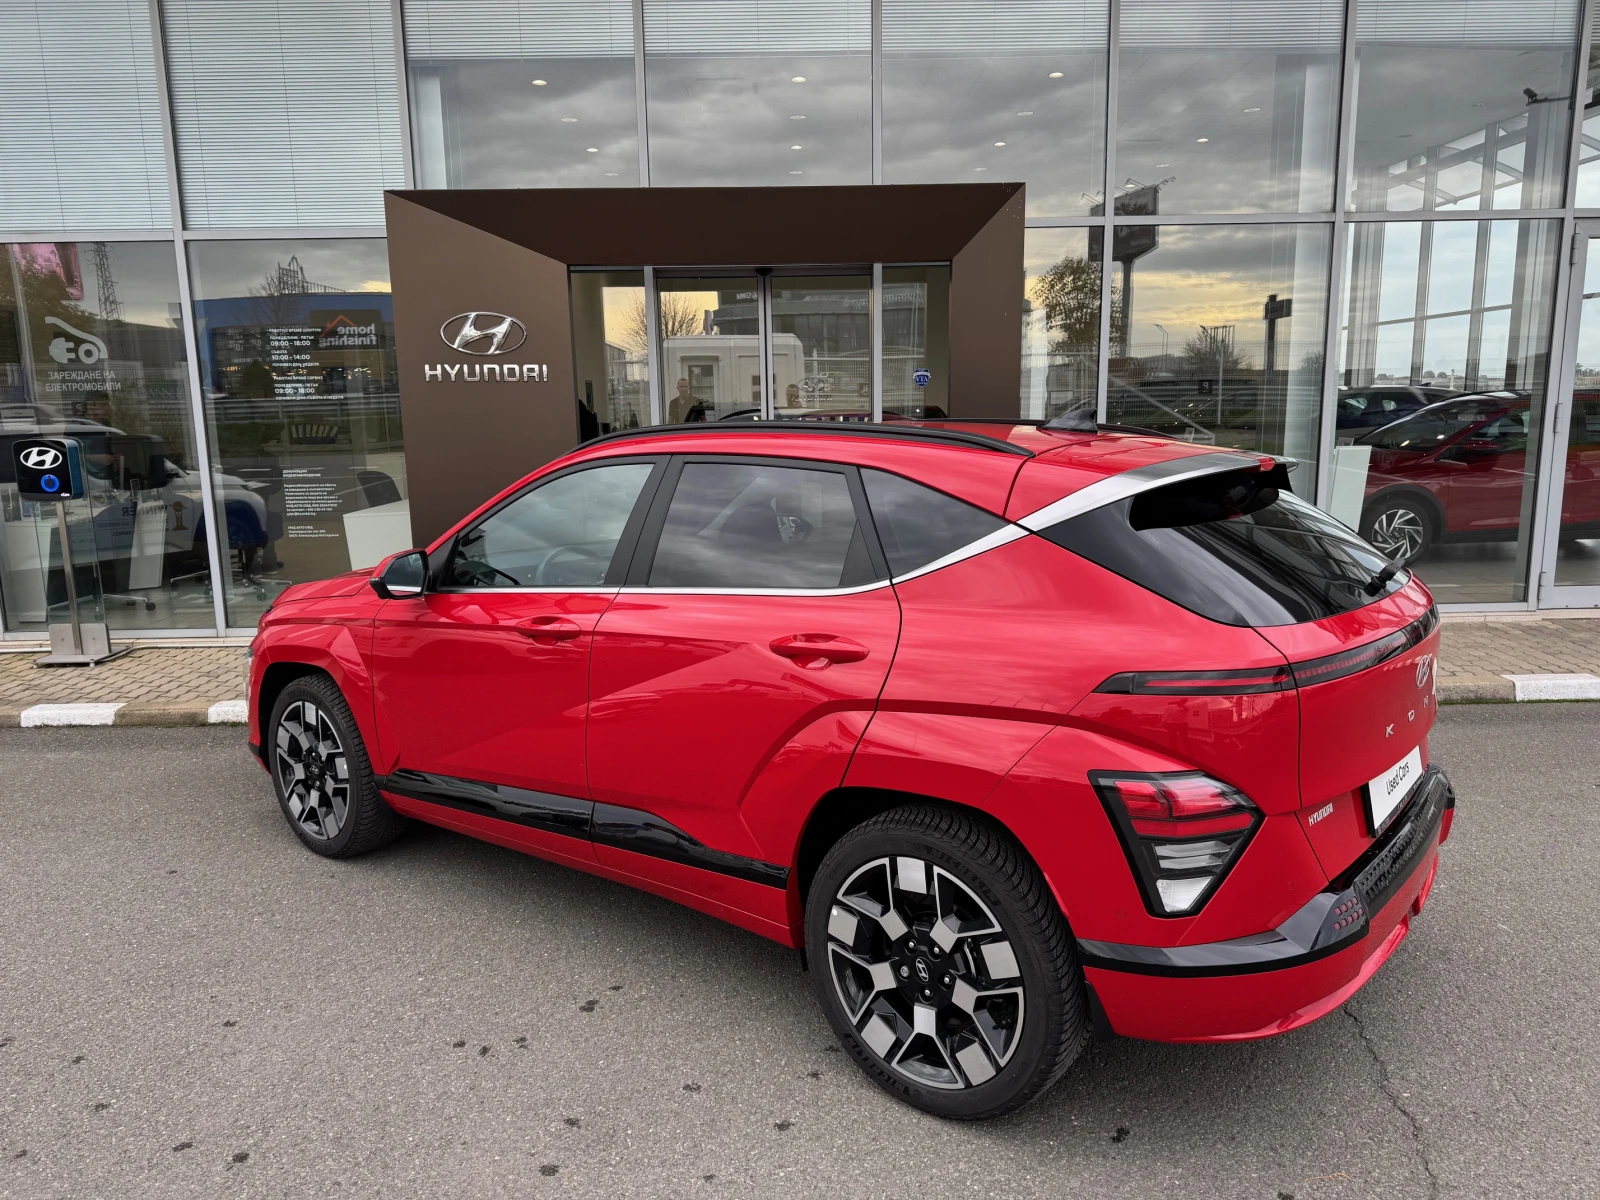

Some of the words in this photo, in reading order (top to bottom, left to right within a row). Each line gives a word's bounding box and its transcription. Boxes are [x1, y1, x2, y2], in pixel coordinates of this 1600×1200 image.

[48, 371, 101, 380] ЗАРЕЖДАНЕ
[103, 371, 116, 379] НА
[424, 364, 548, 381] HYUNDAI
[45, 382, 121, 391] ЕЛЕКТРОМОБИЛИ
[1385, 768, 1400, 795] Used
[1399, 762, 1410, 782] Cars
[1308, 802, 1333, 827] HYUNDAI
